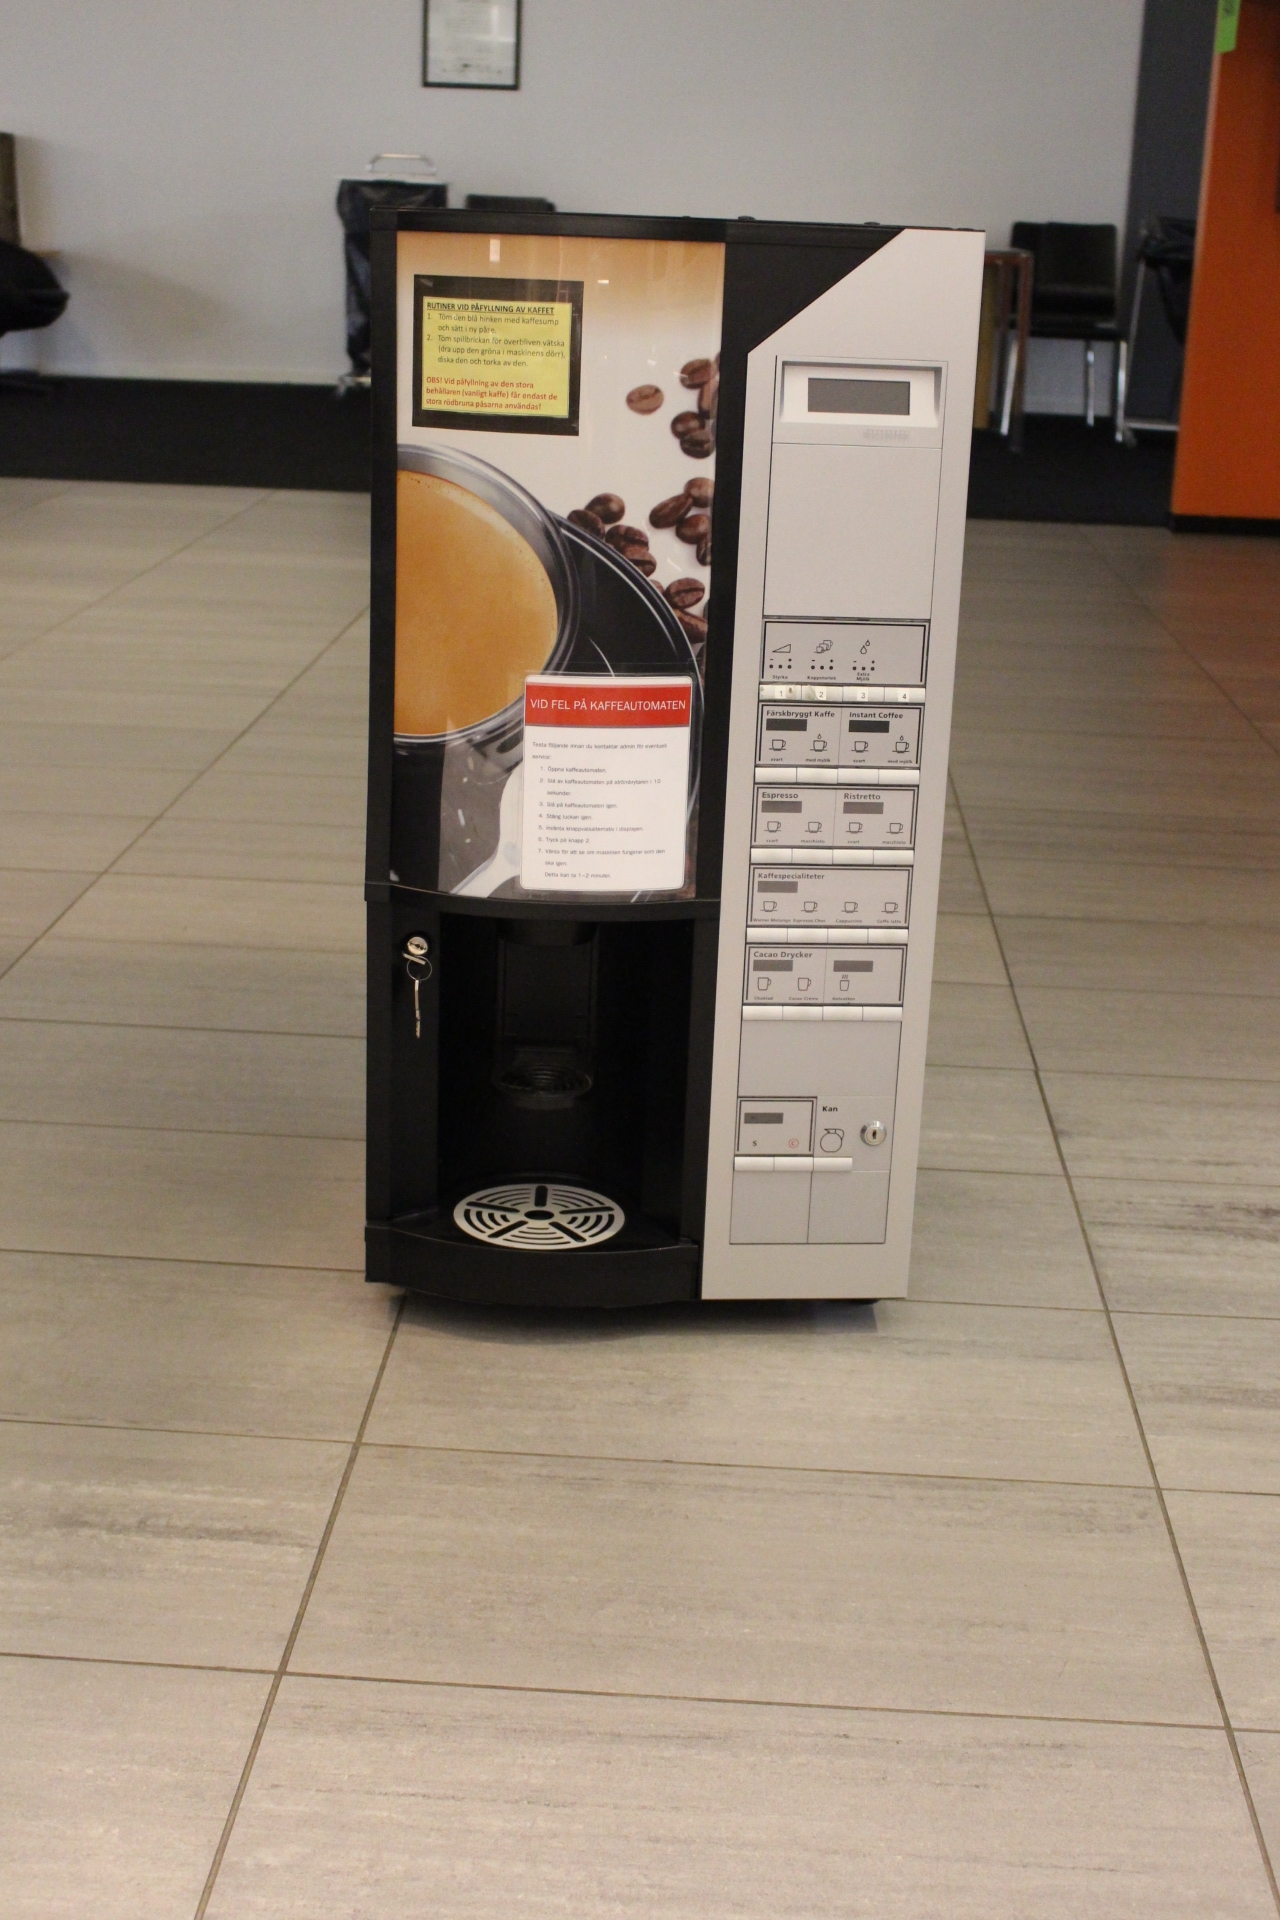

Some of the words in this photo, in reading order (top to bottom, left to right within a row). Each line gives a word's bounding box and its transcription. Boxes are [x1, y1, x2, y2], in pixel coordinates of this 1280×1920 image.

[427, 302, 455, 310] RUTINER
[471, 303, 514, 313] PÅFYLLNING
[468, 314, 477, 322] blå
[480, 315, 502, 323] hinken
[522, 317, 559, 326] kaffesump
[469, 326, 477, 334] ny
[453, 335, 490, 344] spillbrickan
[504, 338, 540, 346] överbliven
[543, 339, 565, 347] vätska
[481, 347, 500, 356] gröna
[507, 348, 544, 357] maskinens
[513, 359, 528, 367] den.
[426, 376, 442, 384] OBS!
[457, 378, 489, 388] påfyllning
[501, 380, 514, 388] den
[426, 387, 461, 395] behållaren
[462, 388, 487, 398] (vanligt
[489, 390, 509, 398] kaffe)
[444, 398, 474, 407] rödbruna
[476, 400, 502, 408] påsarna
[505, 402, 541, 410] användas!
[530, 699, 548, 709] VID
[552, 700, 570, 709] FEL
[574, 698, 587, 710] PÅ
[590, 700, 686, 711] KAFFEAUTOMATEN
[766, 709, 812, 718] Färskbryggt
[548, 766, 564, 774] Öppna
[758, 872, 825, 880] Kaffespecialiteter
[781, 951, 813, 959] Drycker
